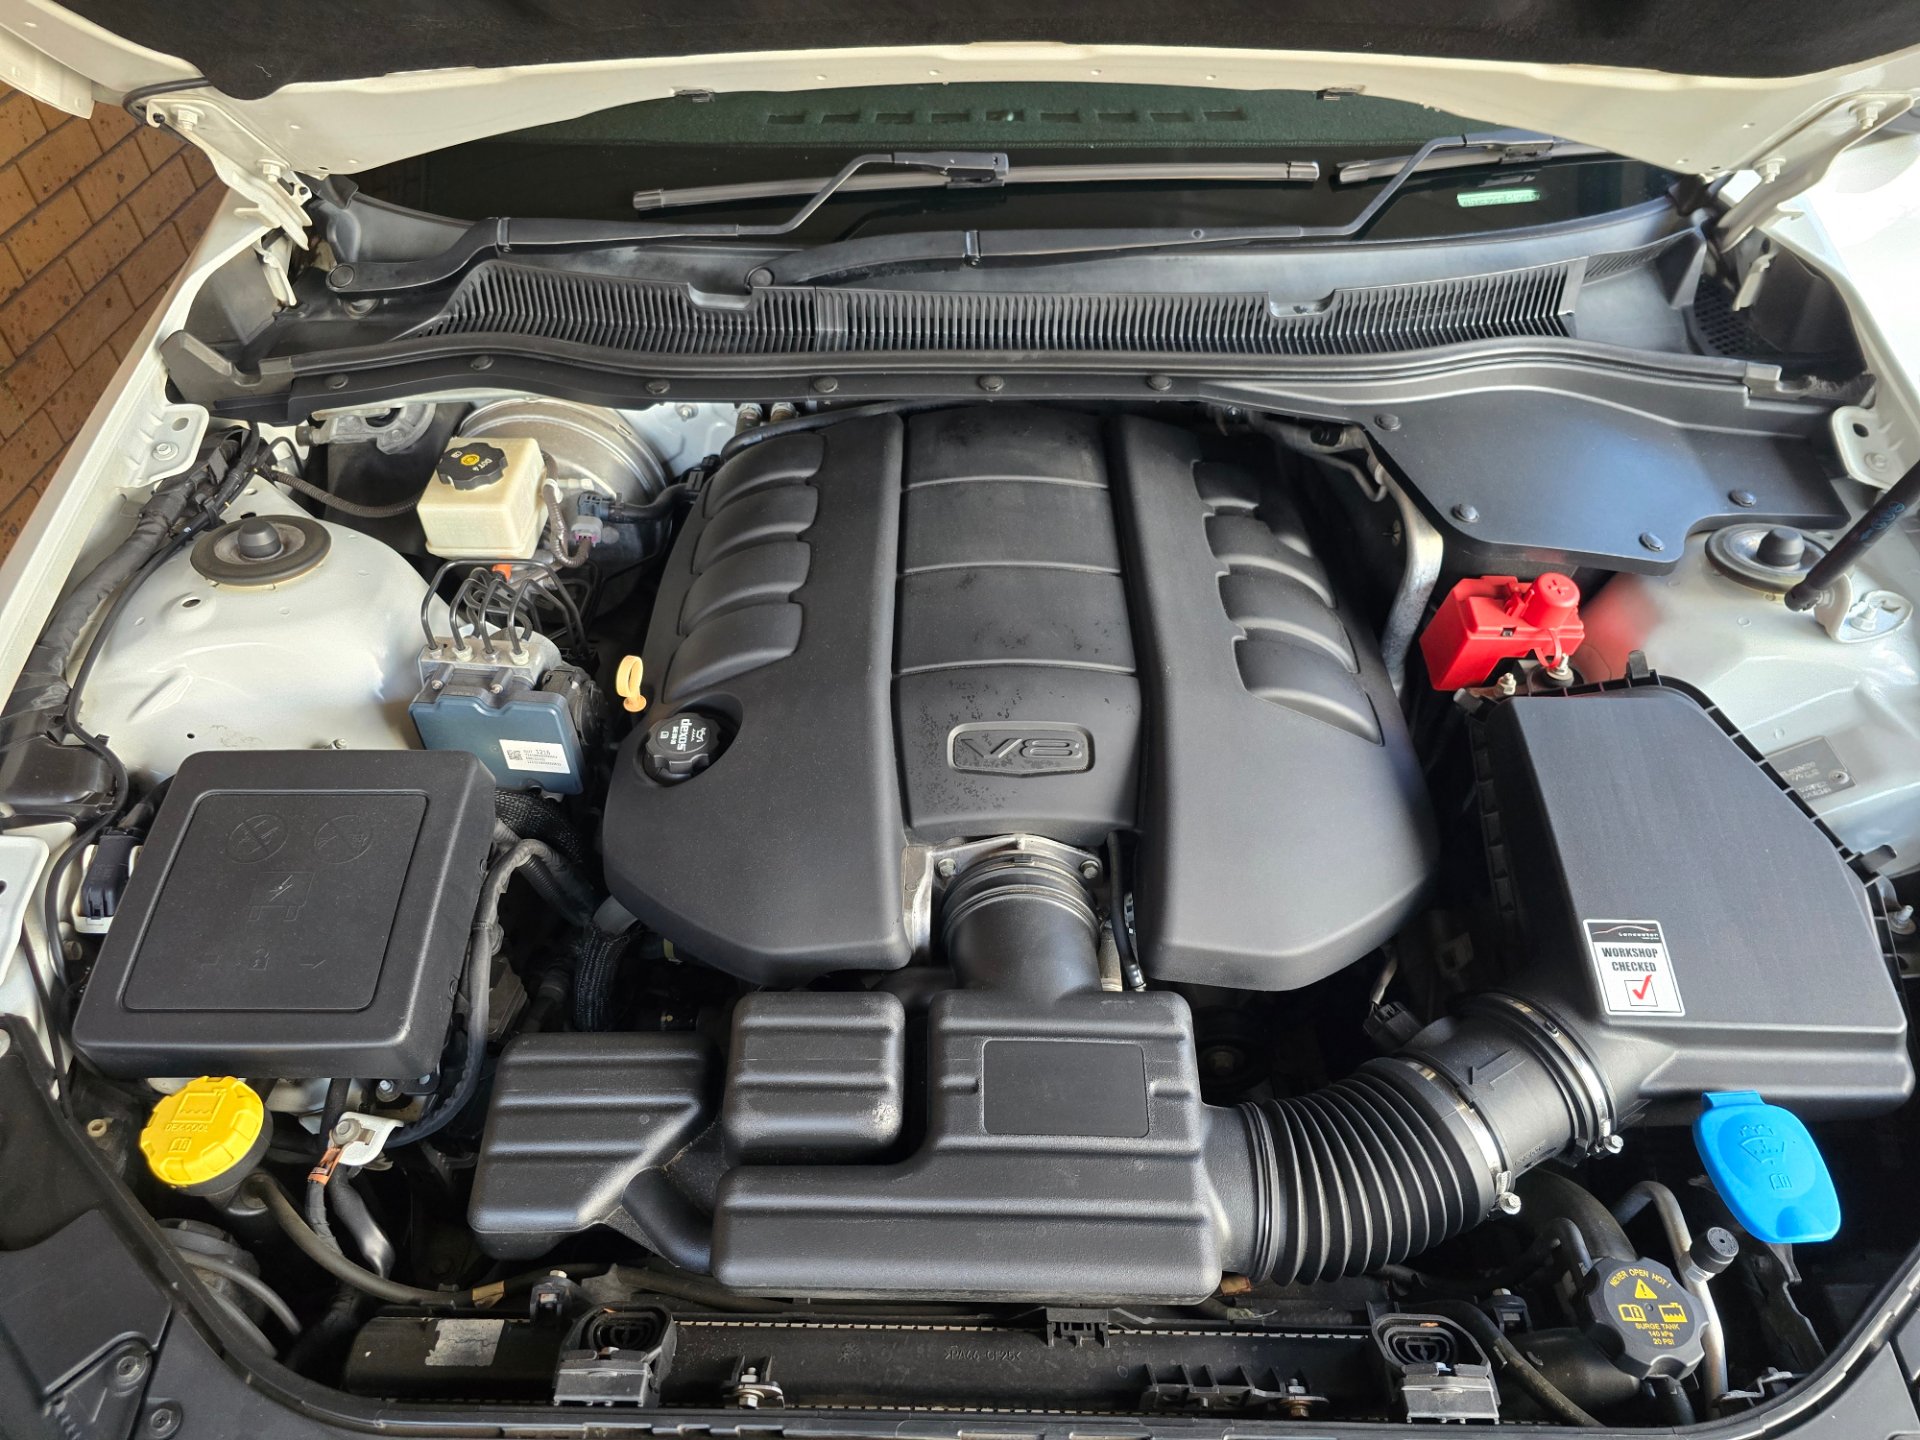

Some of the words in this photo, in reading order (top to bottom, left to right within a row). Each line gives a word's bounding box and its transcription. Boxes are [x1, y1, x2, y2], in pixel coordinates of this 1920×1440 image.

[479, 458, 493, 470] DOT
[676, 718, 692, 752] dexos
[960, 737, 1083, 759] V8
[1601, 947, 1658, 958] WORKSHOP
[1611, 961, 1657, 972] CHECKED
[1609, 1270, 1628, 1288] NEVER
[1629, 1268, 1649, 1278] OPEN
